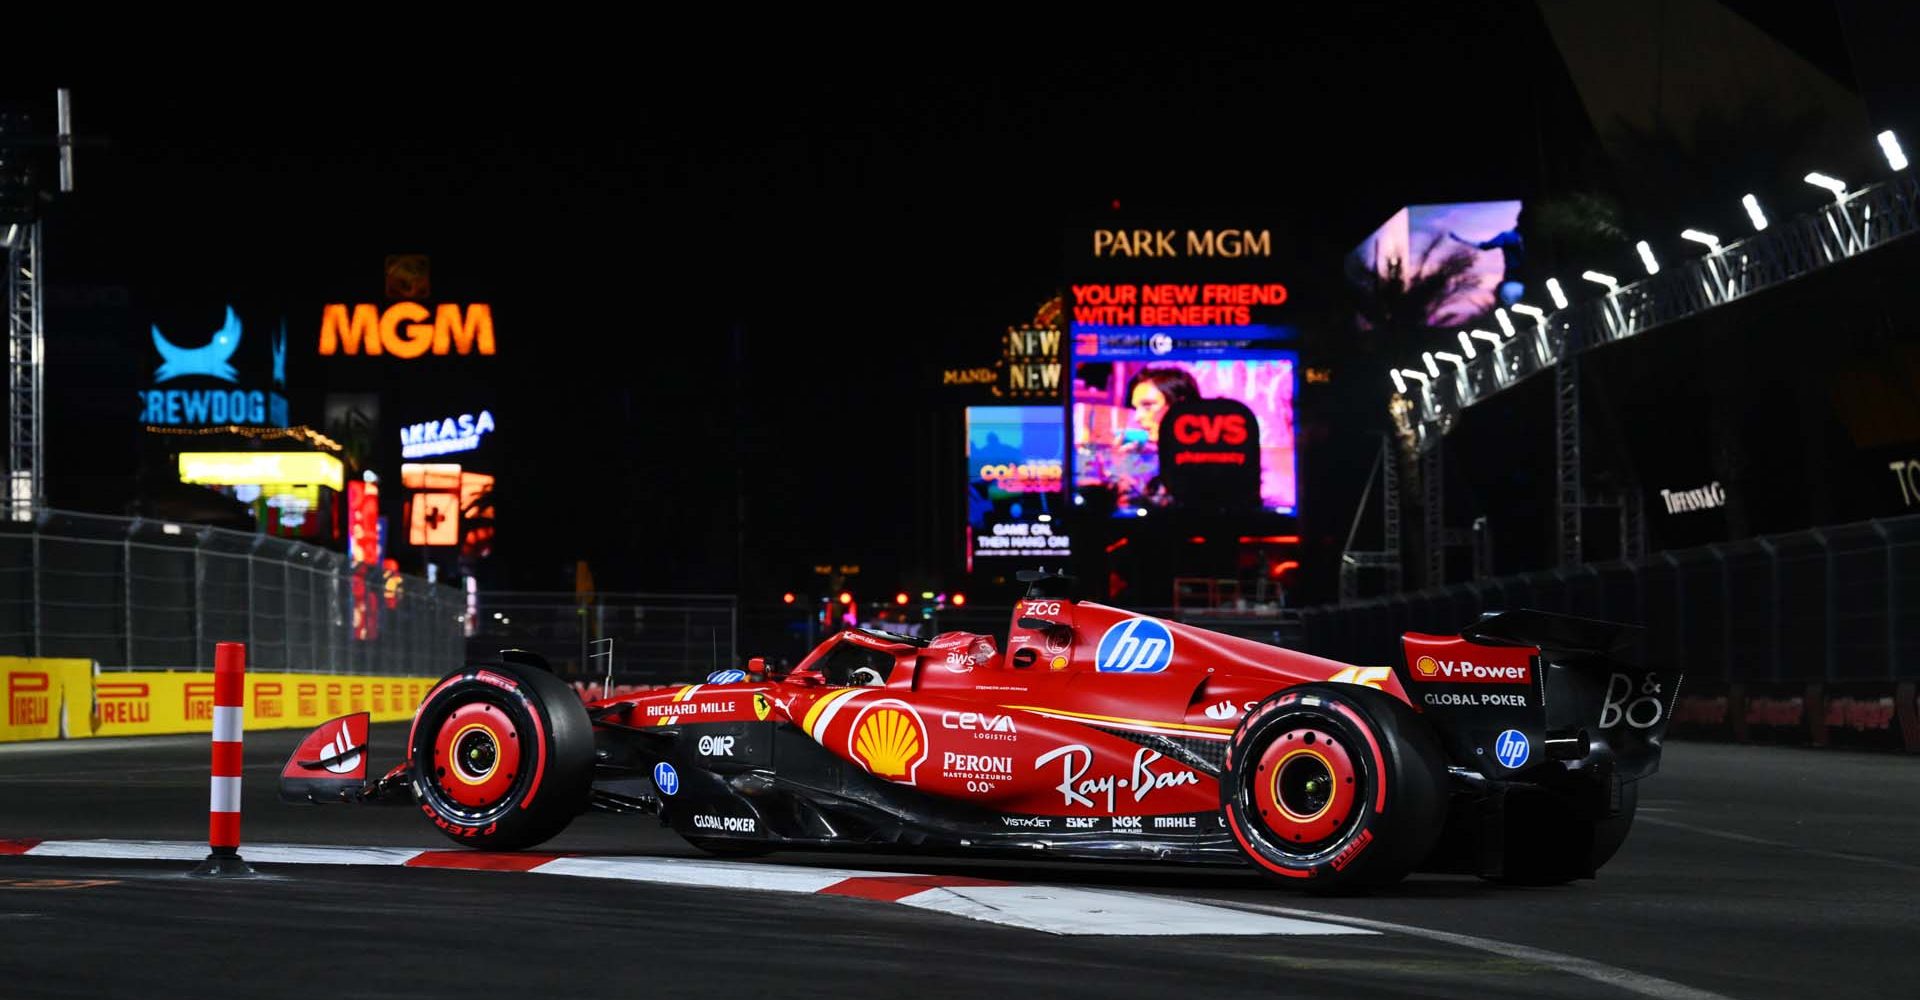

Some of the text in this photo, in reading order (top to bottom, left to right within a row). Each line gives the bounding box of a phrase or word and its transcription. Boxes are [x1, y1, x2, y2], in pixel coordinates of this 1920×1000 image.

[1093, 229, 1271, 257] PARK MGM
[1072, 284, 1288, 305] YOUR NEW FRIEND
[1073, 306, 1250, 326] WITH BENEFITS
[319, 302, 496, 359] MGM
[1009, 330, 1061, 355] NEW
[1009, 364, 1061, 389] NEW
[1173, 414, 1248, 445] CVS
[1025, 602, 1061, 616] ZCG
[1103, 620, 1167, 673] hp
[946, 652, 975, 666] aws
[1439, 661, 1526, 679] V-Power
[647, 701, 736, 716] RICHARD MILLE
[1425, 693, 1527, 707] GLOBAL POKER
[974, 732, 1017, 742] LOGISTICS
[943, 752, 1012, 773] PERONI
[658, 762, 677, 795] hp
[694, 815, 755, 833] GLOBAL POKER
[1066, 817, 1099, 828] SKF
[1112, 816, 1142, 828] NGK
[1154, 817, 1197, 828] MAHLE
